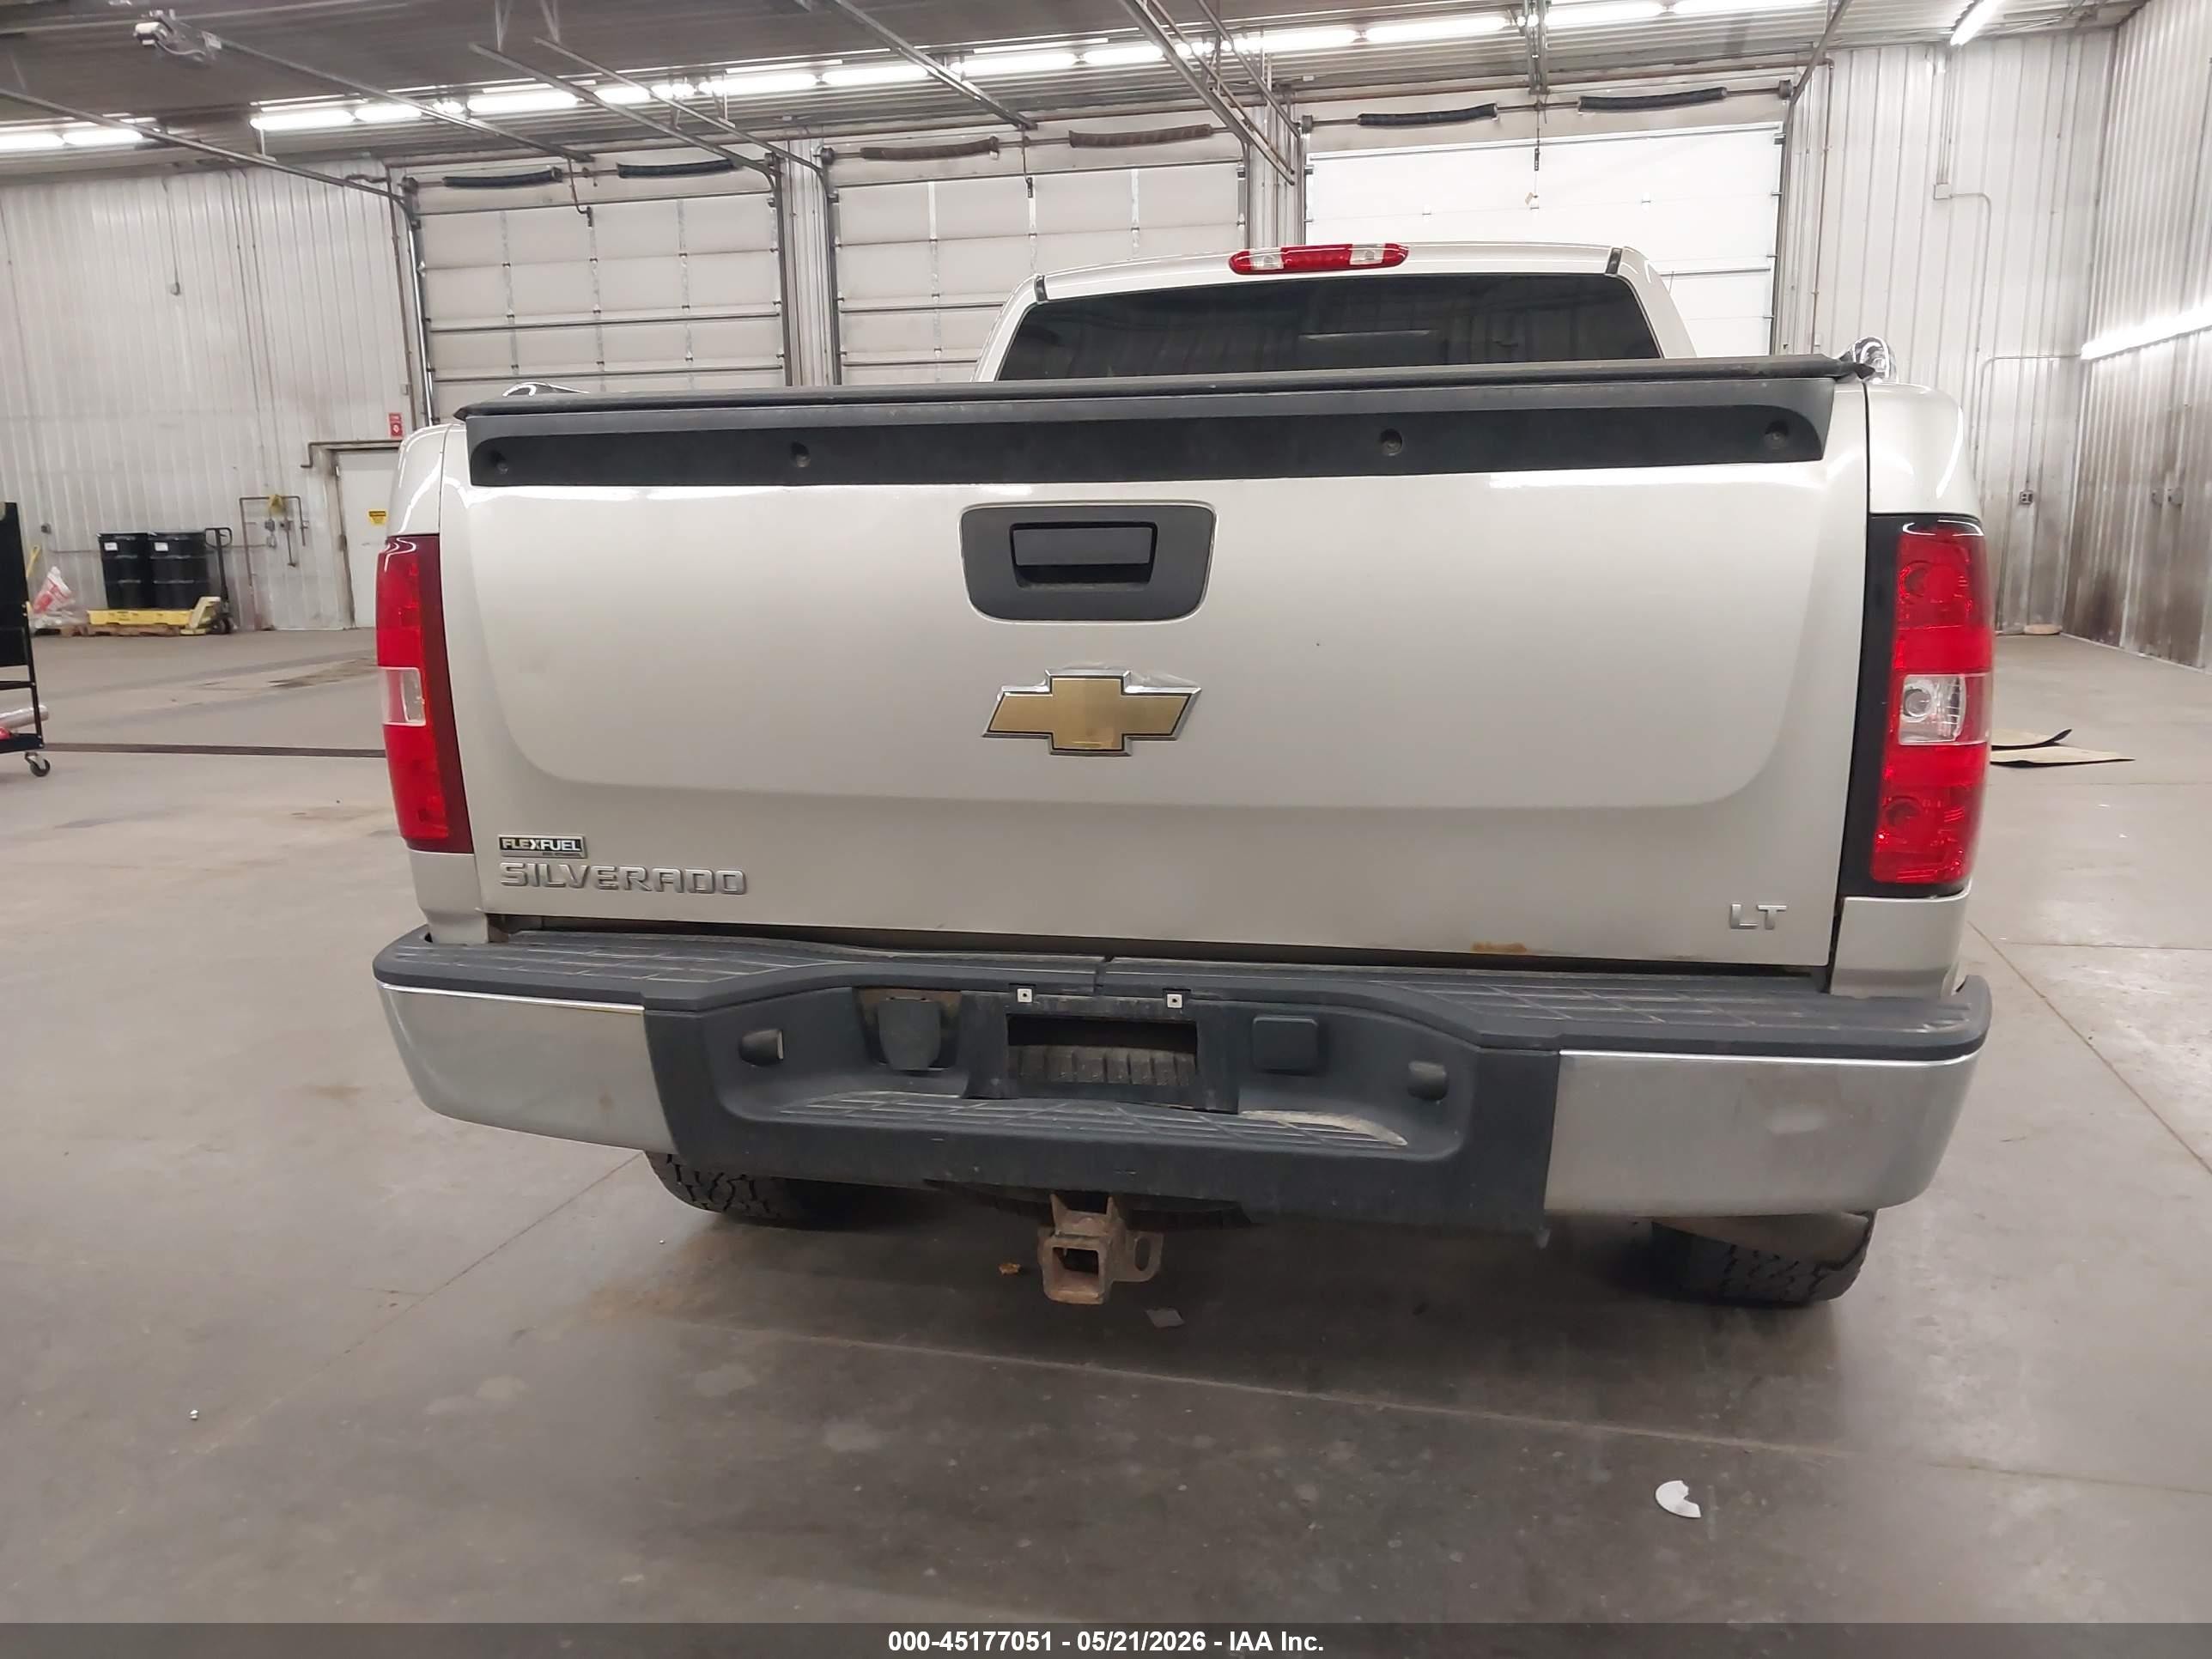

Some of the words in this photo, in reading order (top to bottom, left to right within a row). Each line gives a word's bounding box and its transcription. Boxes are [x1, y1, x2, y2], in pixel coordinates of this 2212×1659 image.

[501, 838, 581, 851] FLEXFUEL
[501, 862, 747, 895] SILVERADO
[1729, 903, 1787, 930] LT
